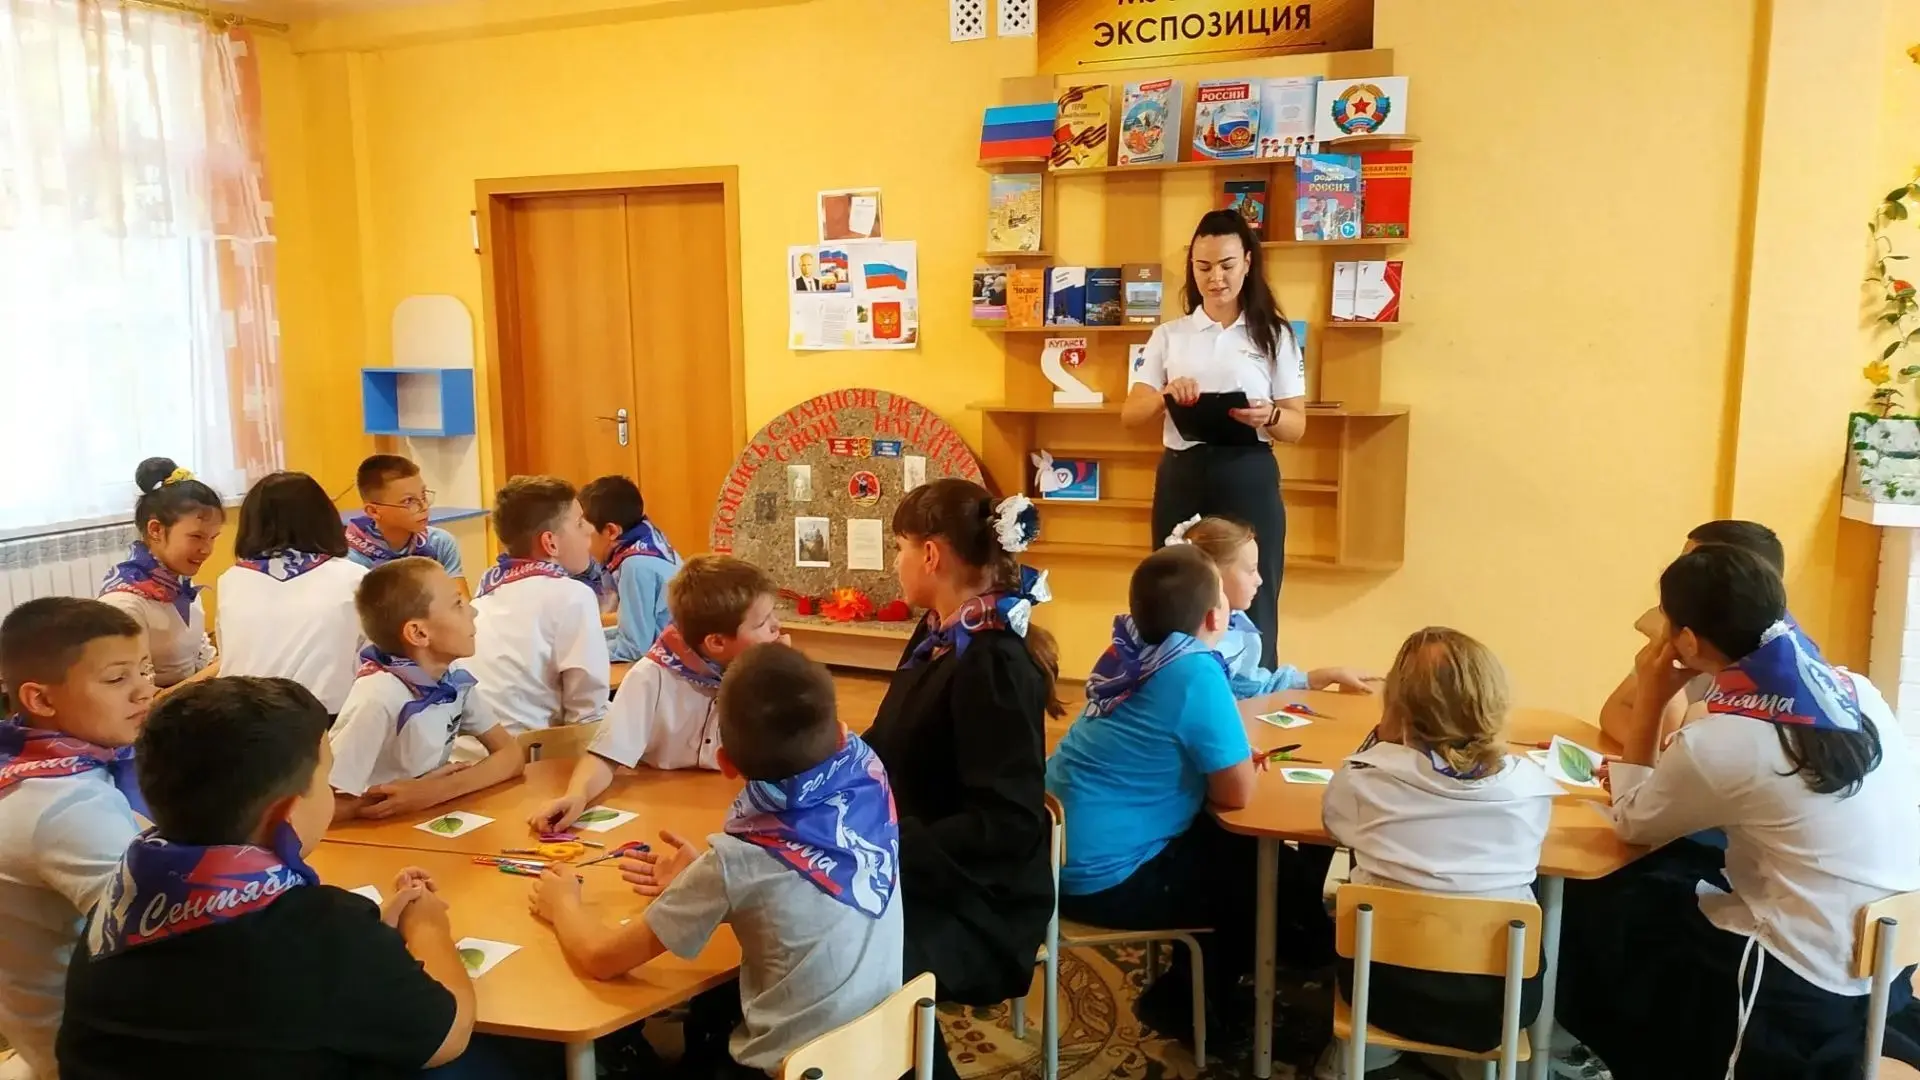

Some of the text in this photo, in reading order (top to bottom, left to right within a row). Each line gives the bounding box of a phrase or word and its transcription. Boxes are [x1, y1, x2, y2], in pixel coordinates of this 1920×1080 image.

[1093, 4, 1311, 47] ЭКСПОЗИЦИЯ
[1201, 90, 1245, 102] РОССИИ
[1308, 183, 1350, 192] РОССИЯ
[1048, 340, 1084, 348] ЛУГАНСК
